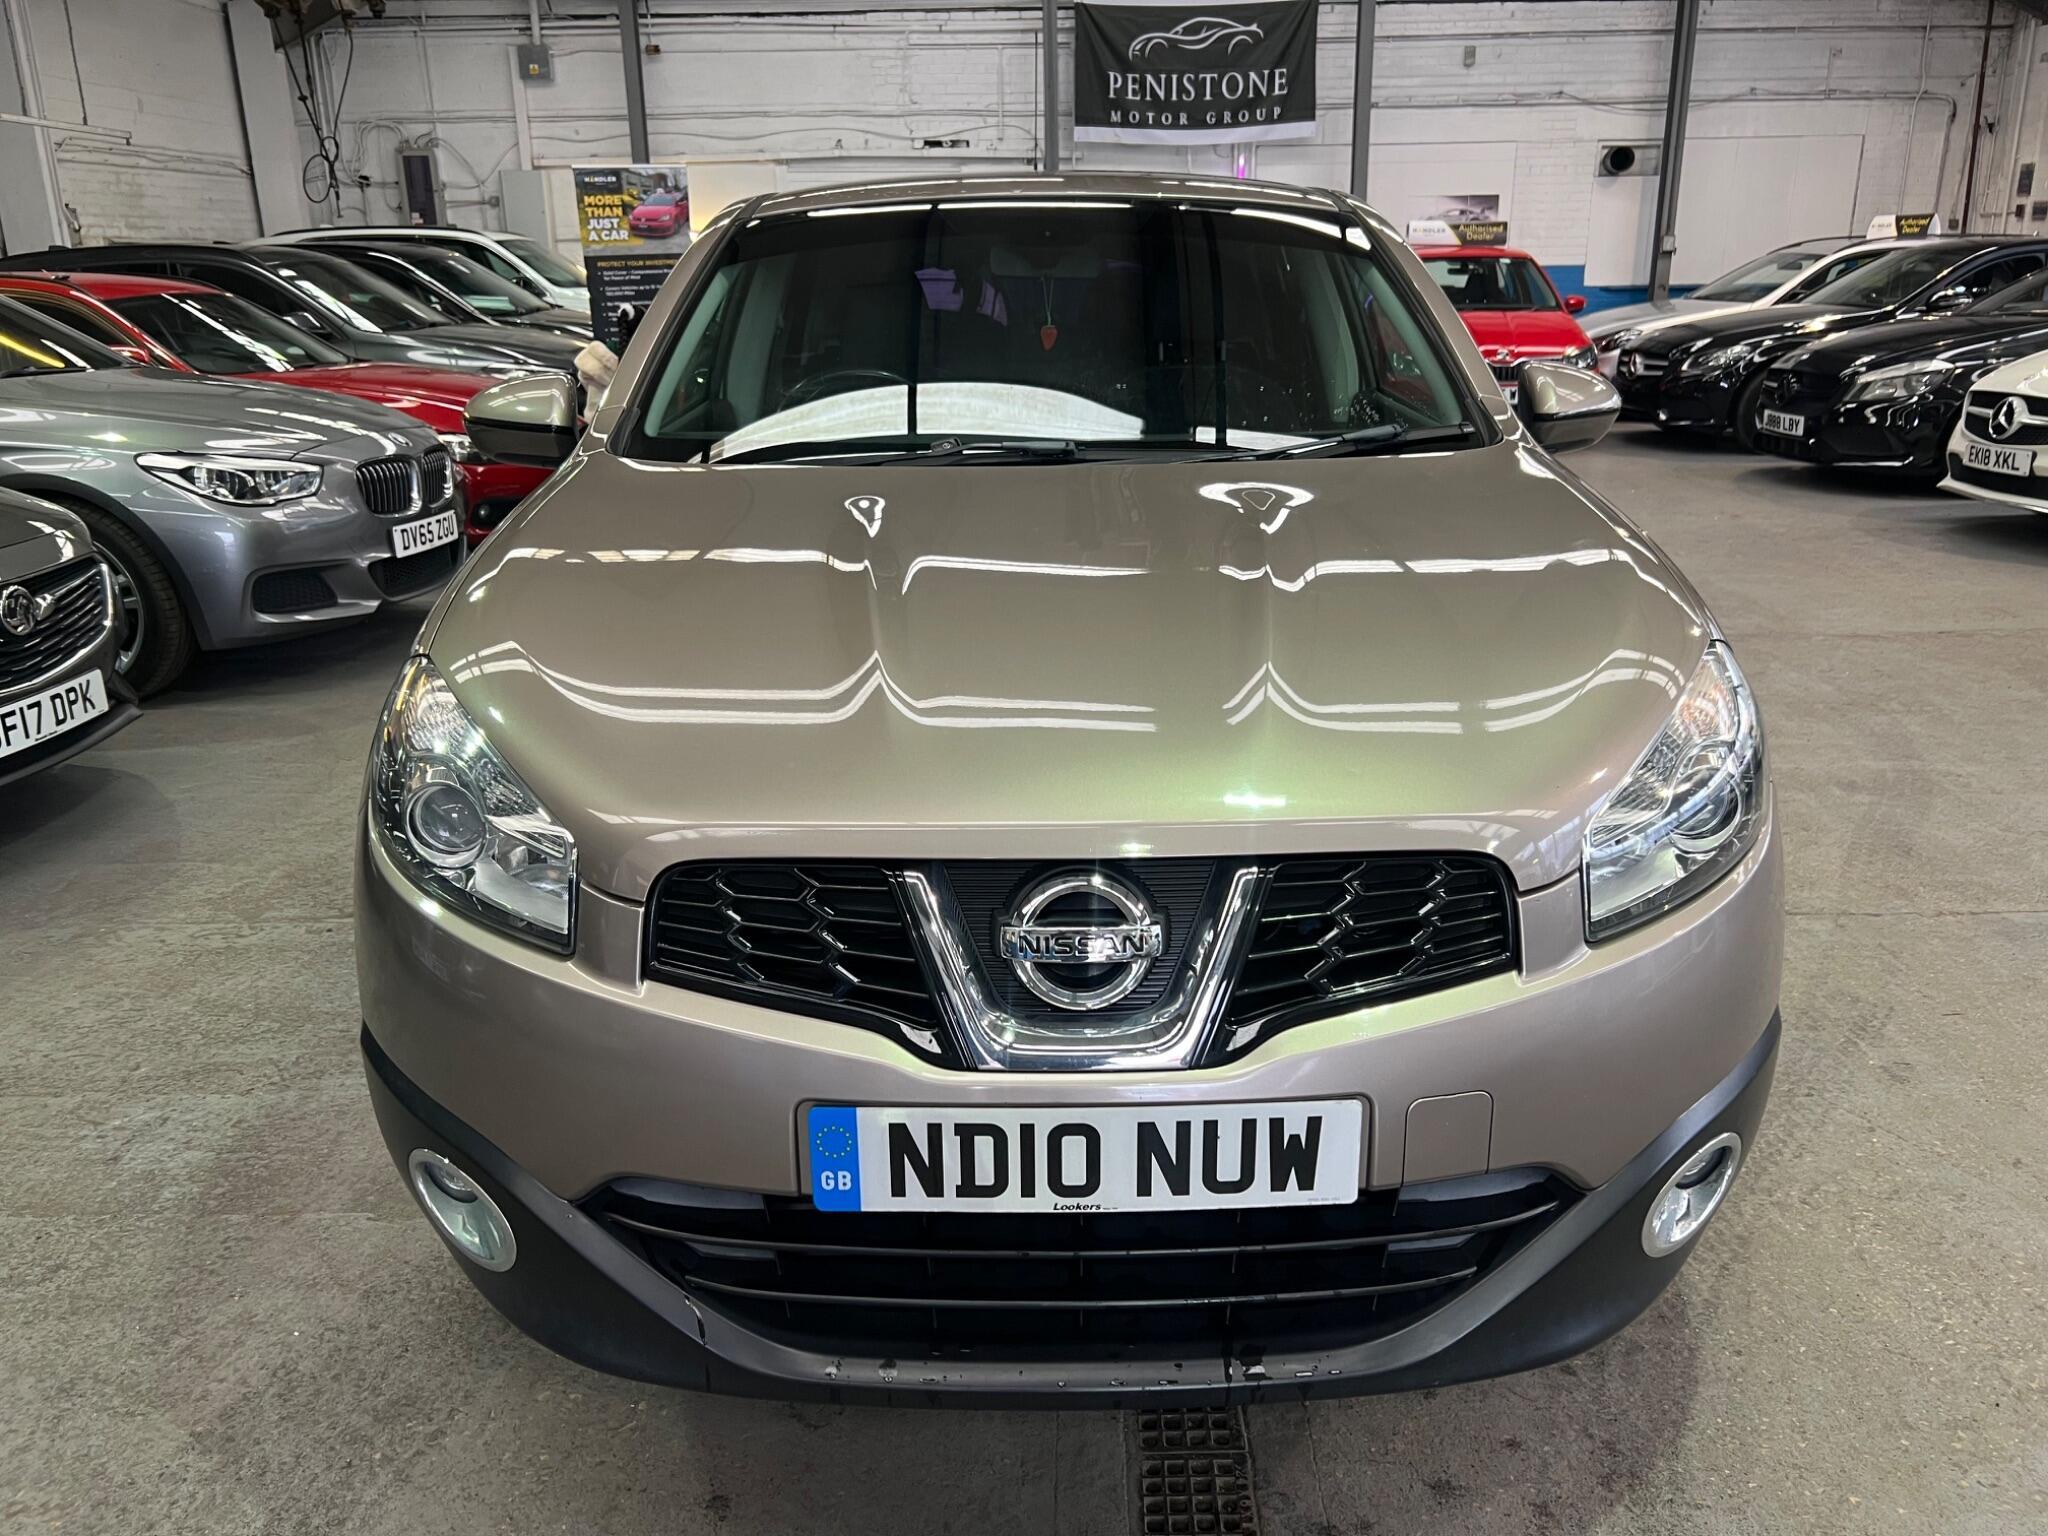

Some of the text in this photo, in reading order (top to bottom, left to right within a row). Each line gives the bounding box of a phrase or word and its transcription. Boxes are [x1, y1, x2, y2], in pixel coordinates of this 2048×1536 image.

[1107, 68, 1289, 102] PENISTONE
[1110, 106, 1282, 126] MOTOR GROUP
[583, 195, 623, 206] MORE
[585, 206, 623, 218] THAN
[587, 218, 620, 230] JUST
[1458, 222, 1504, 234] Authorised
[588, 229, 629, 241] A CAR
[1466, 231, 1495, 241] Dealer
[1782, 416, 1800, 433] LBY
[1968, 445, 2020, 471] EK18 XKL
[400, 514, 455, 551] DV65 ZGU
[0, 679, 96, 748] F17 DPK
[1017, 933, 1147, 955] NISSAN
[887, 1116, 1323, 1199] ND10 NUW
[820, 1170, 852, 1191] GB
[1053, 1202, 1102, 1211] Lookers
